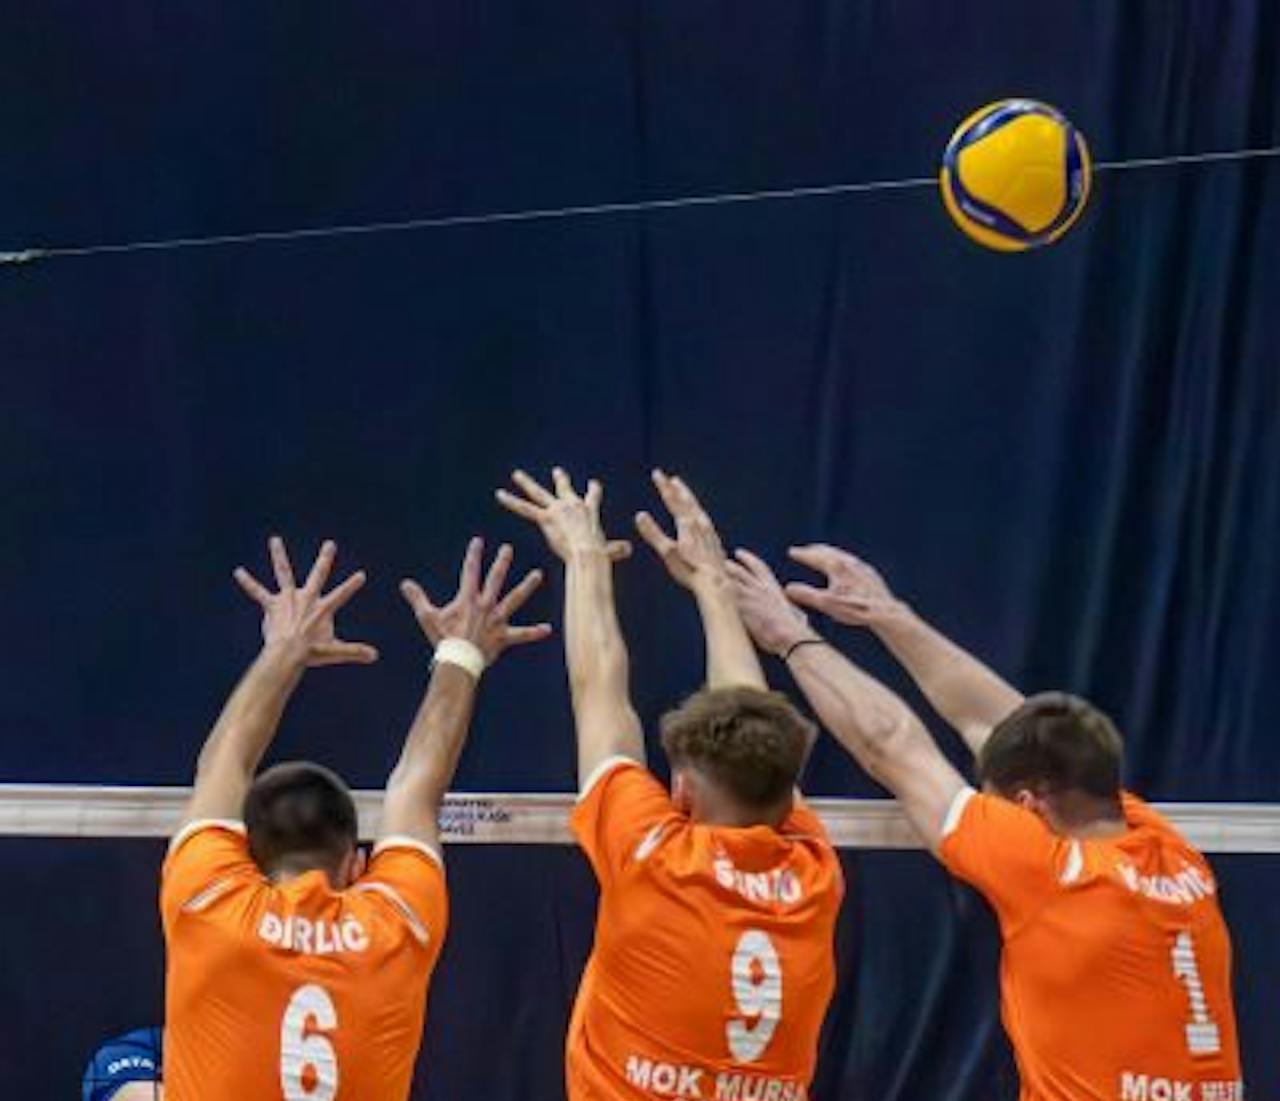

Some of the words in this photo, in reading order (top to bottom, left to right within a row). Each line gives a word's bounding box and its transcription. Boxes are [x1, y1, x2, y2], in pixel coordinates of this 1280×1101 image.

[725, 928, 782, 1063] 9
[1171, 929, 1221, 1056] 1
[625, 1055, 704, 1098] MOK
